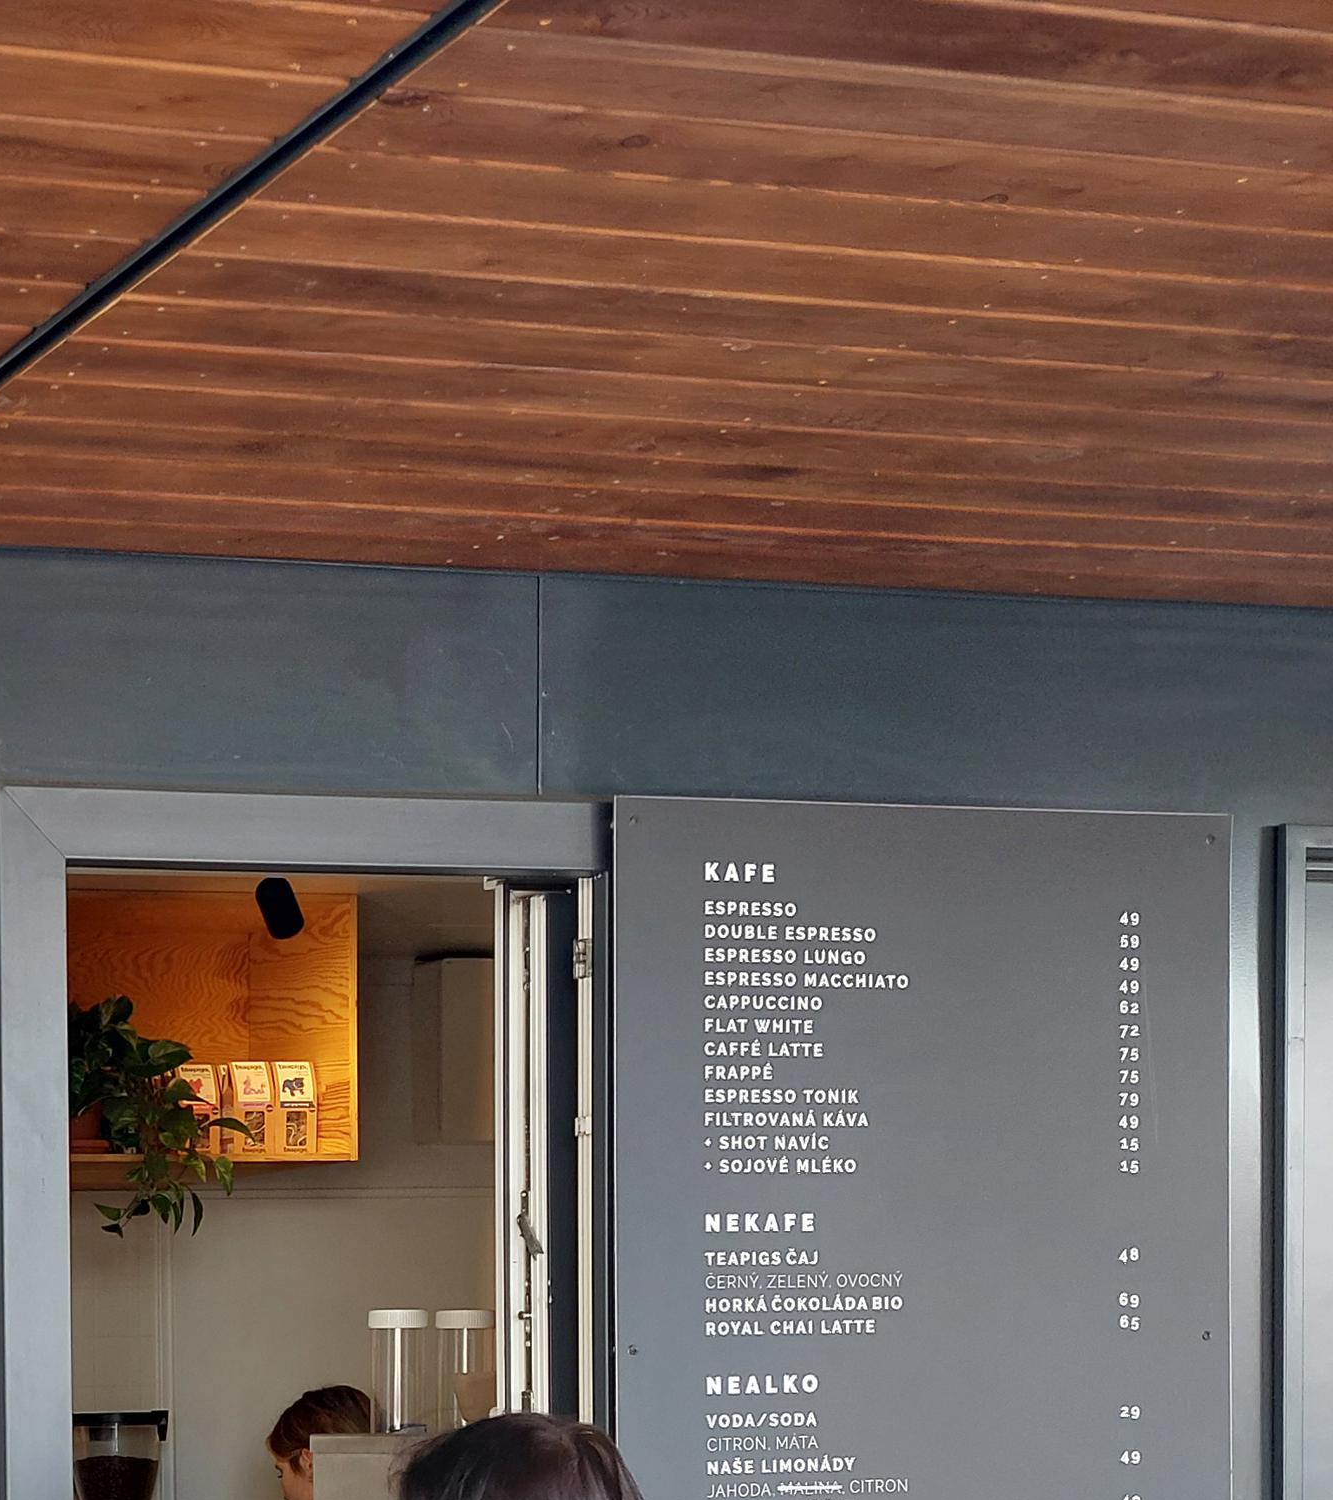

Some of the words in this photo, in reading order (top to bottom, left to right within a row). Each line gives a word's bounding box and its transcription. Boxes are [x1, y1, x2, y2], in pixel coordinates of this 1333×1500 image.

[705, 862, 774, 882] KAFE
[705, 901, 796, 916] ESPRESSO
[1120, 912, 1139, 926] 49
[705, 924, 777, 939] DOUBLE
[785, 926, 876, 941] ESPRESSO
[1120, 935, 1139, 948] 59
[705, 948, 796, 963] ESPRESSO
[804, 949, 865, 964] LUNGO
[1119, 957, 1139, 971] 49
[705, 971, 796, 987] ESPRESSO
[804, 973, 908, 989] MACCHIATO
[1119, 980, 1139, 993] 49
[704, 995, 822, 1010] CAPPUCCINO
[1120, 1001, 1139, 1013] 62
[705, 1018, 748, 1032] FLAT
[754, 1019, 813, 1034] WHITE
[1120, 1025, 1140, 1039] 72
[704, 1039, 761, 1056] CAFFÉ
[768, 1042, 823, 1057] LATTE
[1119, 1048, 1139, 1062] 75
[705, 1063, 772, 1080] FRAPPÉ
[1120, 1070, 1139, 1083] 75
[705, 1089, 796, 1104] ESPRESSO
[803, 1088, 858, 1104] TONIK
[1119, 1093, 1138, 1106] 79
[705, 1110, 816, 1126] FILTROVANÁ
[823, 1109, 868, 1126] KÁVA
[1119, 1115, 1138, 1129] 49
[719, 1136, 768, 1150] SHOT
[775, 1133, 828, 1150] NAVÍC
[1120, 1138, 1139, 1151] 15
[719, 1156, 788, 1172] SOJOVÉ
[797, 1156, 856, 1173] MLÉKO
[1120, 1160, 1138, 1173] 15
[705, 1213, 814, 1232] NEKAFE
[704, 1252, 781, 1266] TEAPIGS
[786, 1248, 818, 1265] ČAJ
[1119, 1248, 1139, 1262] 48
[837, 1271, 902, 1287] OVOCNÝ
[706, 1295, 767, 1313] HORKÁ
[771, 1294, 868, 1311] ČOKOLÁDA
[872, 1296, 902, 1310] BIO
[1119, 1293, 1139, 1307] 69
[706, 1321, 765, 1335] ROYAL
[770, 1320, 812, 1334] CHAI
[821, 1320, 875, 1333] LATTE
[1120, 1315, 1140, 1330] 65
[706, 1374, 818, 1394] NEALKO
[706, 1412, 816, 1428] VODA/SODA
[1120, 1406, 1140, 1419] 29
[776, 1433, 818, 1449] MÁTA
[707, 1457, 755, 1475] NAŠE
[762, 1455, 855, 1473] LIMONÁDY
[1120, 1451, 1140, 1464] 49
[850, 1479, 908, 1493] CITRON
